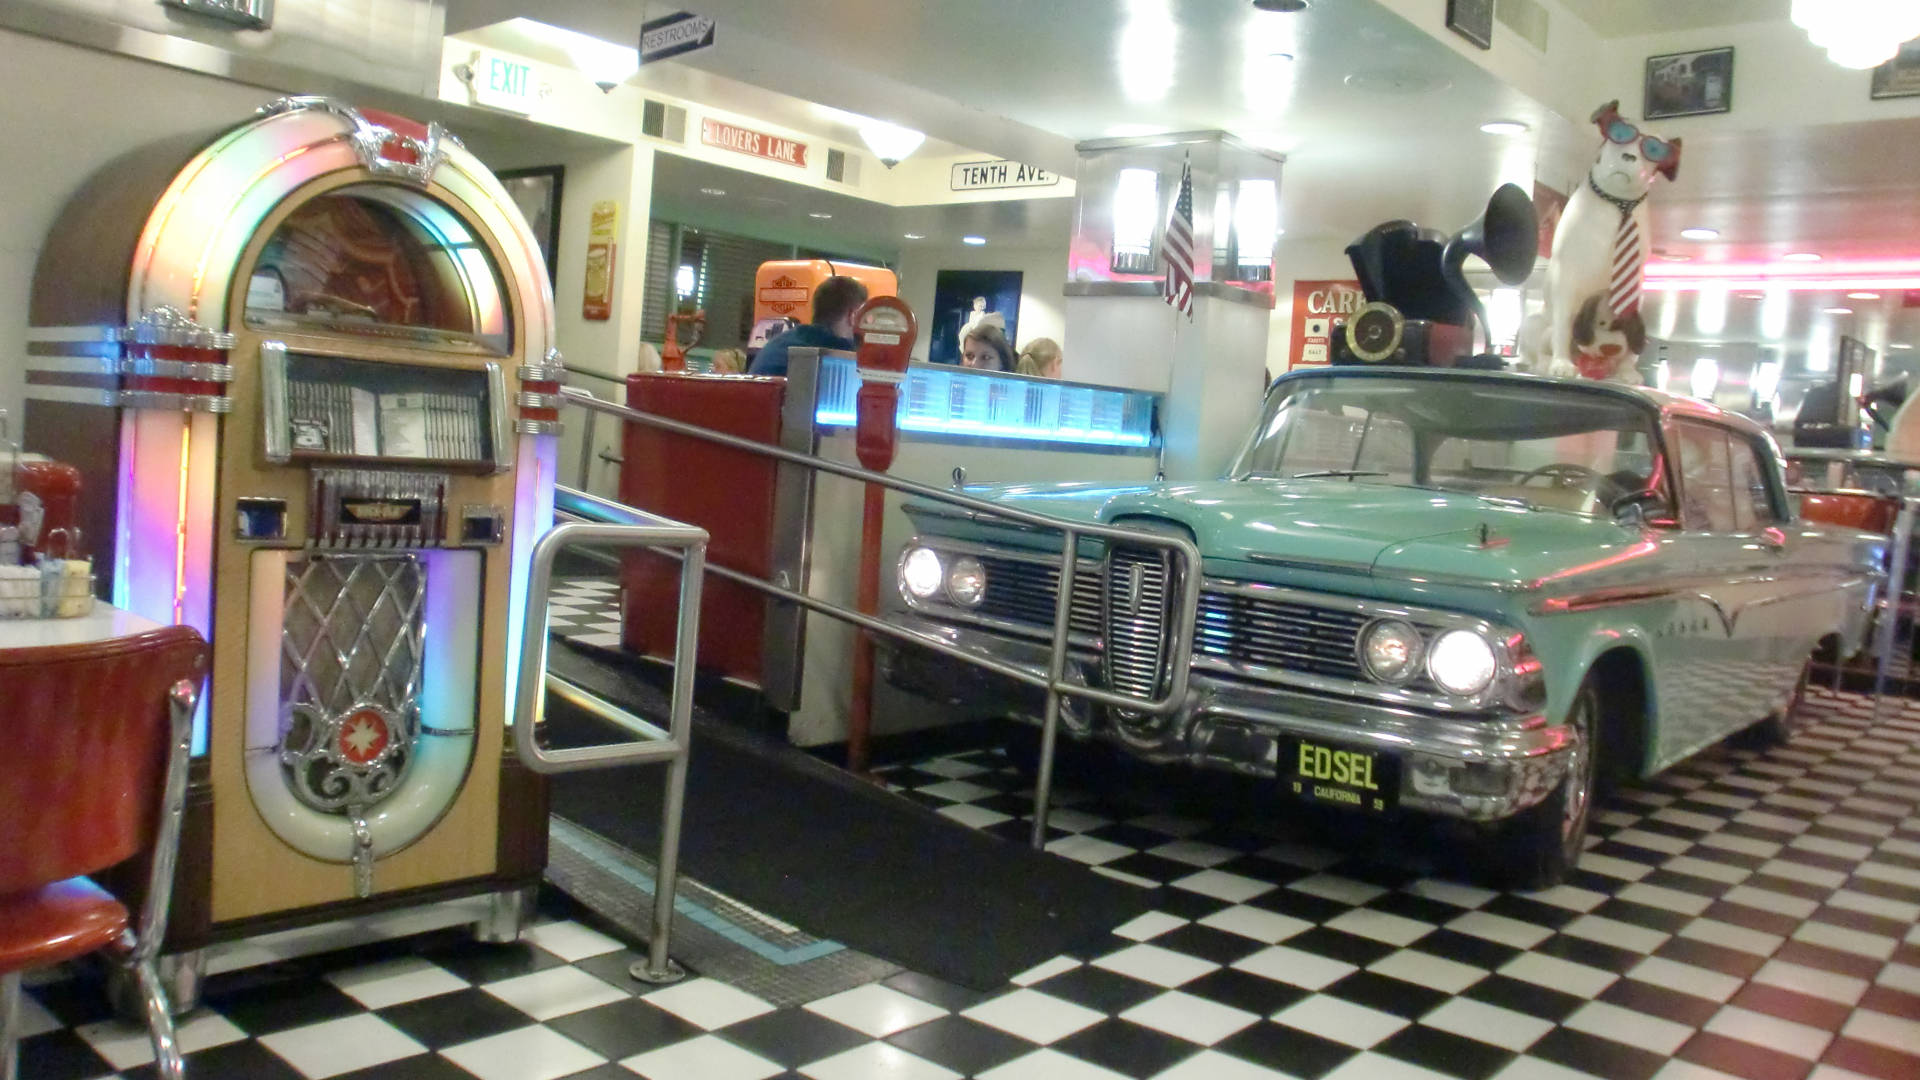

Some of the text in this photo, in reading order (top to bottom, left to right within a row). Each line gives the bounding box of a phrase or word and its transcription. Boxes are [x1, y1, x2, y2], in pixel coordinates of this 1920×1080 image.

[644, 18, 709, 48] RESTROOMS
[490, 58, 531, 97] EXIT
[715, 124, 797, 162] LOVERS LANE
[963, 163, 1048, 185] TENTH AVE.
[1300, 743, 1378, 790] EDSEL
[1314, 785, 1361, 805] CALIFORNIA
